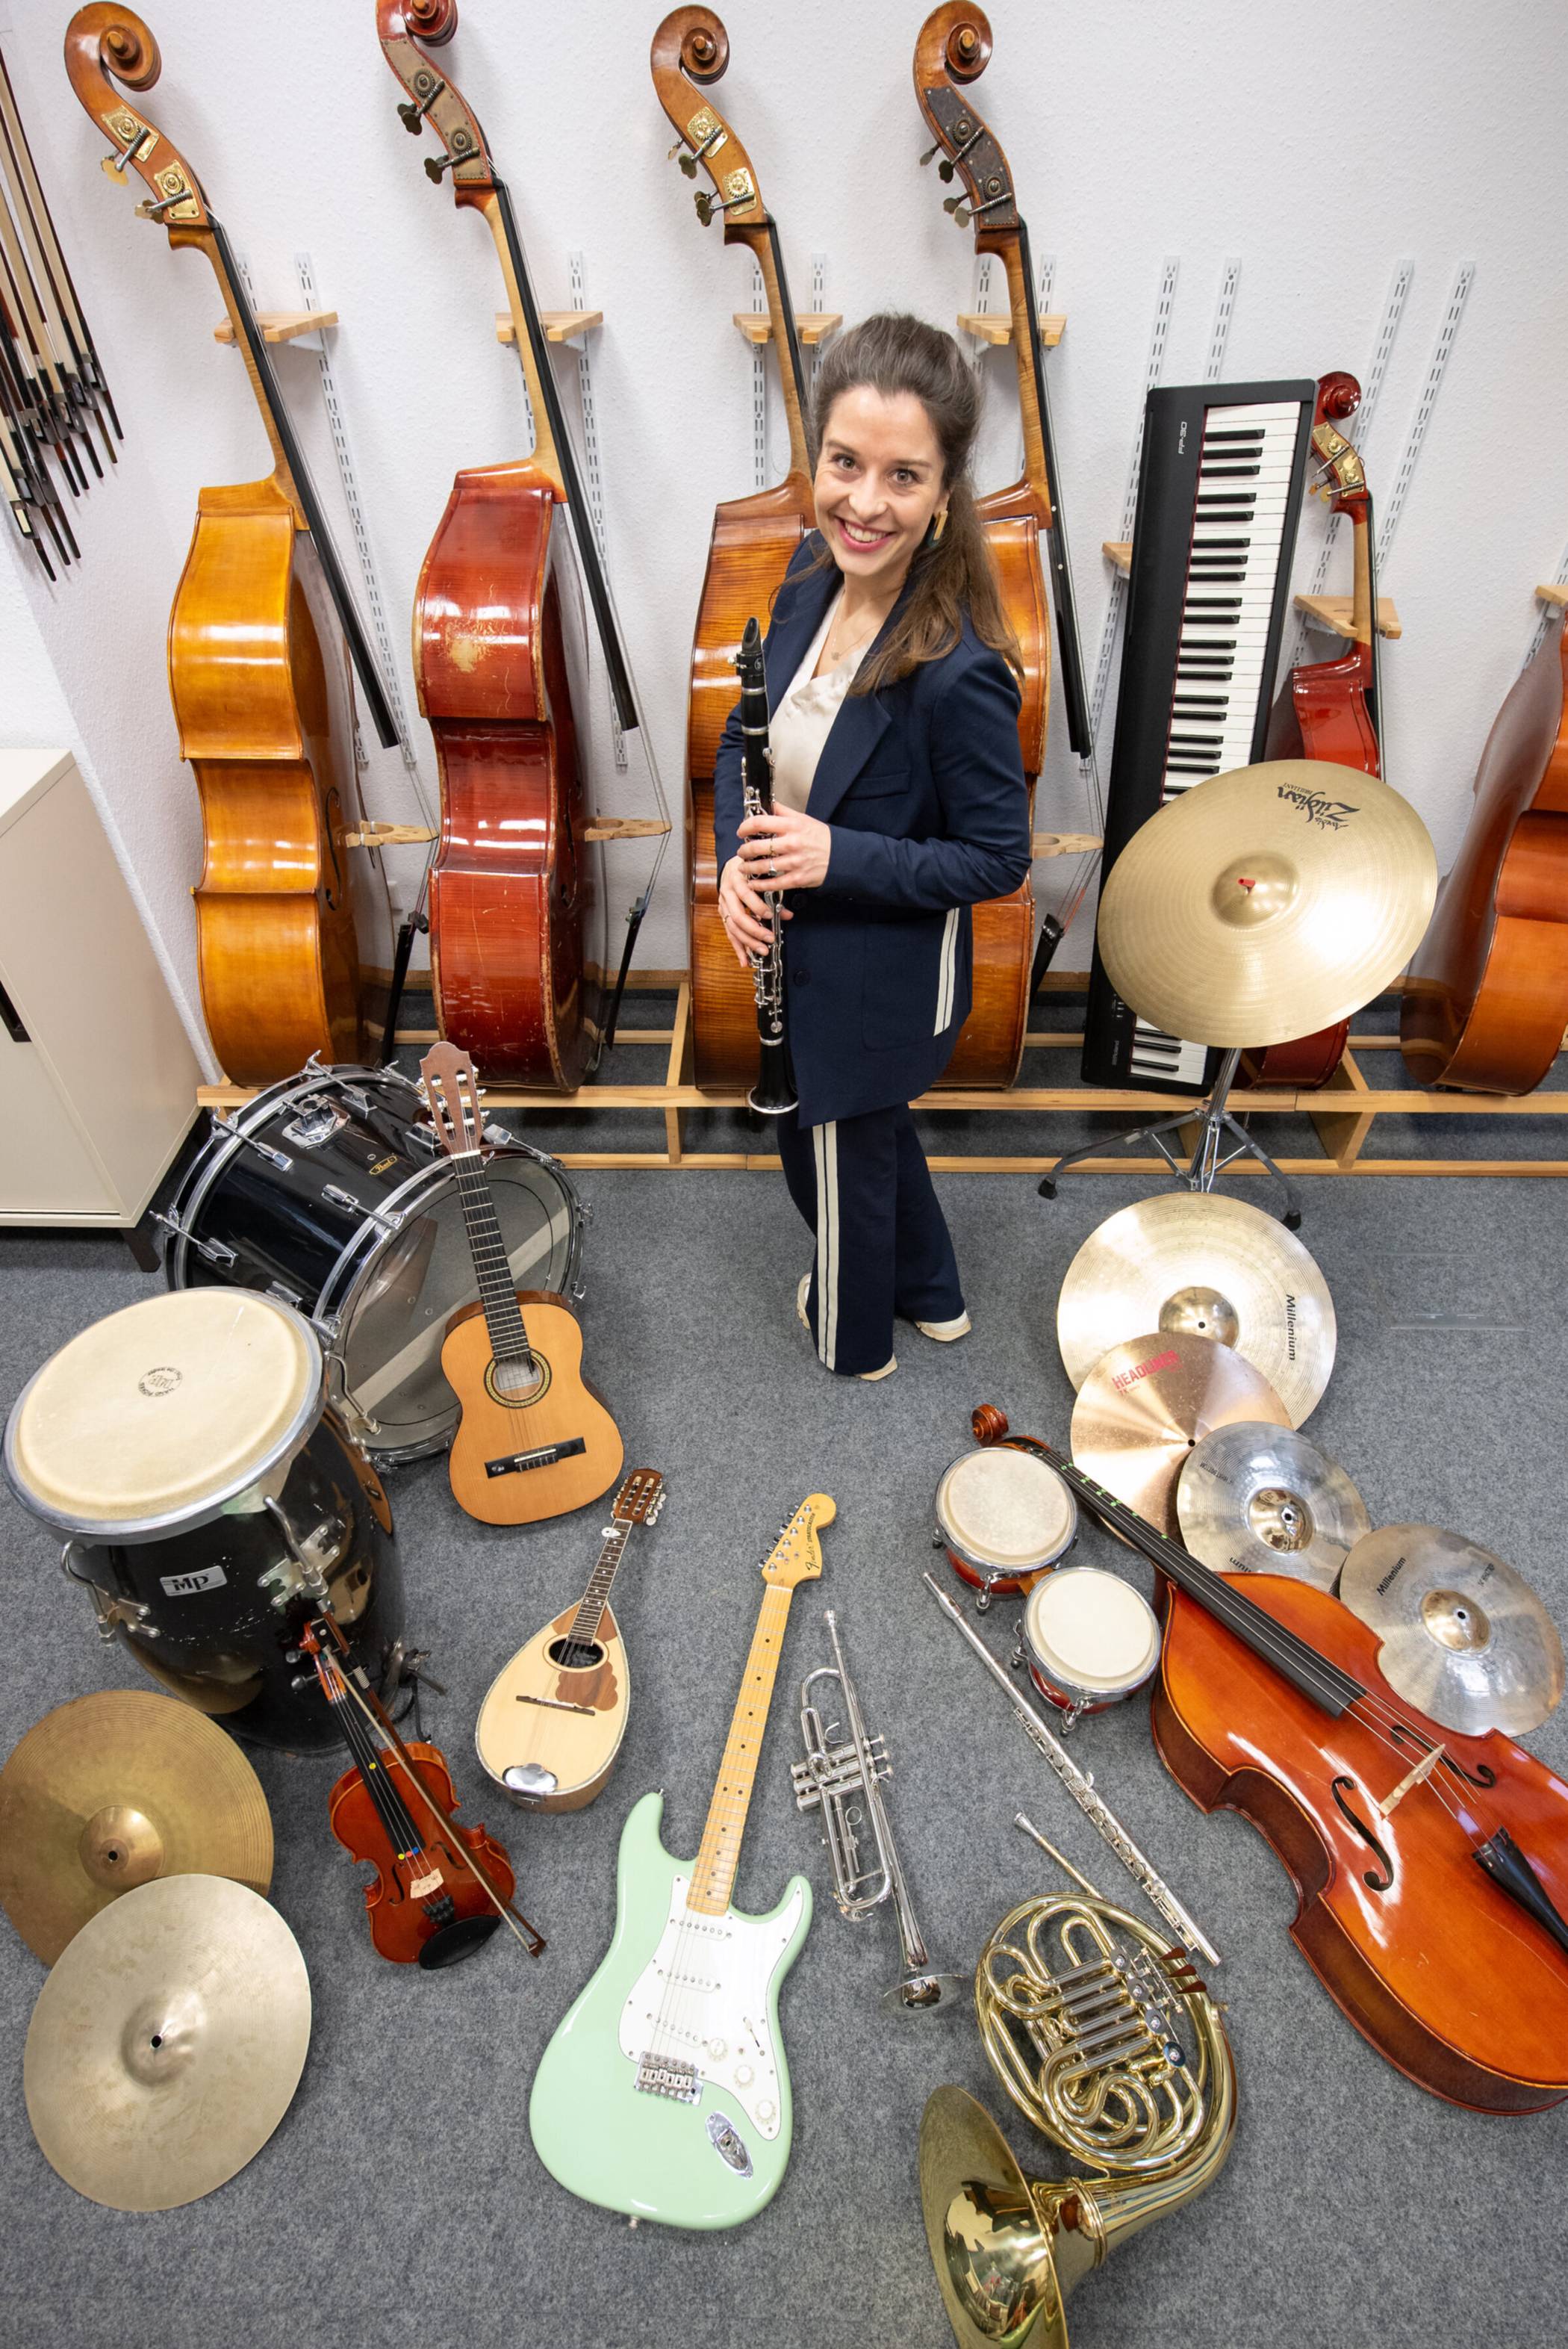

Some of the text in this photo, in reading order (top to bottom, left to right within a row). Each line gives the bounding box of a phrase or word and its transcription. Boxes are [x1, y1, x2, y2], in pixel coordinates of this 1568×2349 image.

[1178, 421, 1187, 454] FP-30
[1278, 786, 1360, 822] Zildjian
[1286, 1294, 1297, 1361] Millenium
[172, 1576, 208, 1590] MP
[1376, 1557, 1407, 1596] Millenium
